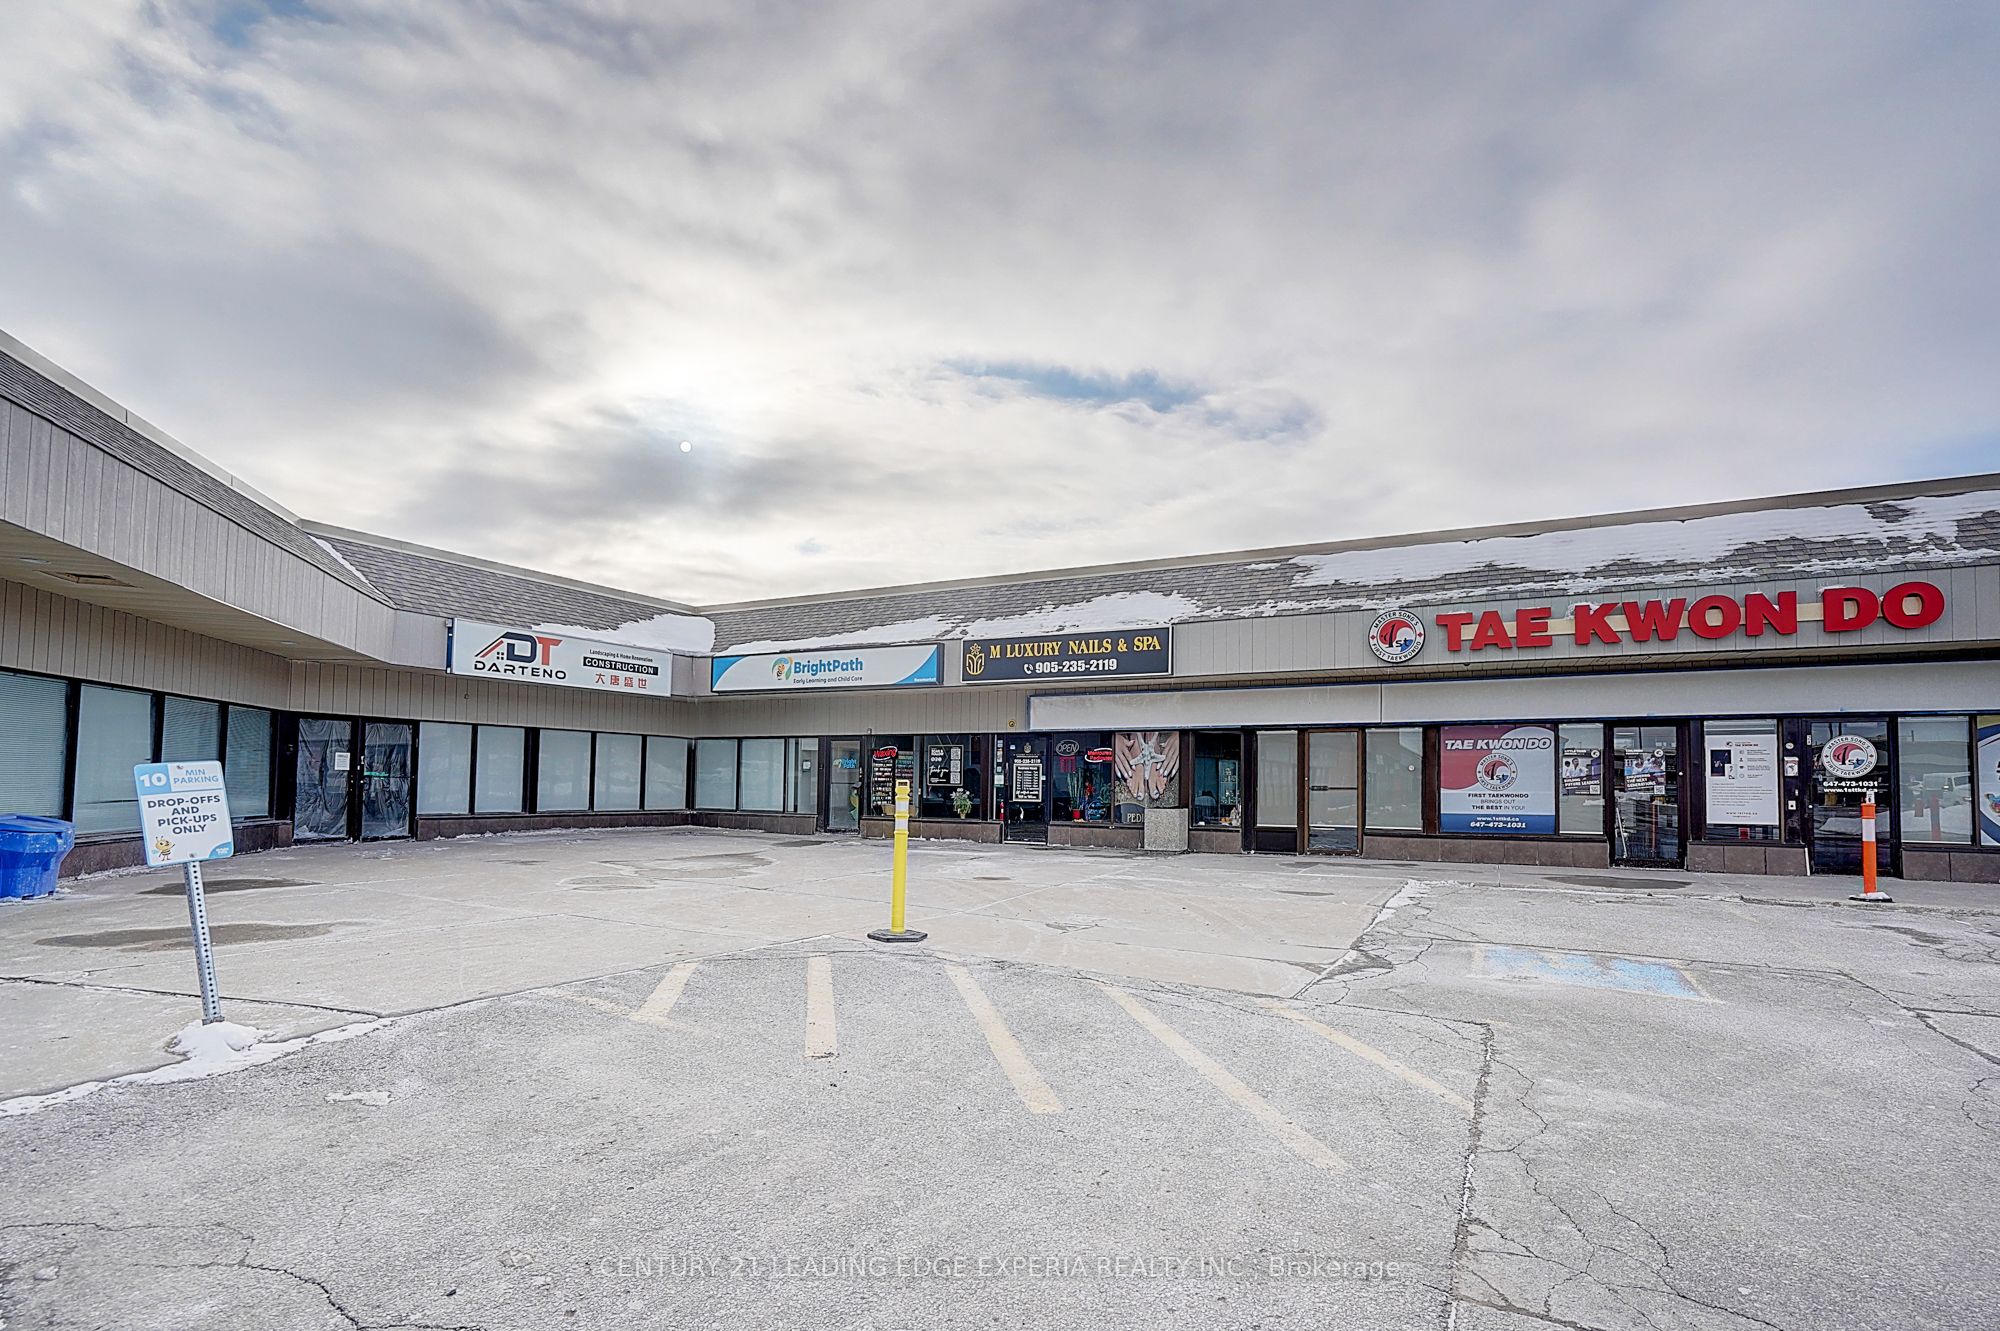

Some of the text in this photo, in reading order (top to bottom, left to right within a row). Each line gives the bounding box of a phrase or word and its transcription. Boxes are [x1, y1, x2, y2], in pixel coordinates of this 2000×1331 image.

[1374, 611, 1419, 628] MASTER SONG'S
[1436, 582, 1945, 651] TAE KWON DO
[589, 649, 616, 659] Landscaping
[990, 635, 1161, 659] M LUXURY NAILS & SPA
[1372, 641, 1422, 661] FIRST TAEKWONDO
[474, 660, 567, 680] DARTENO
[585, 658, 654, 674] CONSTRUCTION
[794, 657, 863, 676] BrightPath
[1035, 658, 1117, 674] 905-235-2119
[595, 673, 647, 689] 大唐盛世
[1059, 743, 1077, 753] OPEN
[1445, 737, 1552, 750] TAE KWON DO
[1827, 737, 1849, 749] MASTER
[1480, 755, 1497, 766] MASTER
[185, 769, 206, 777] MIN
[1826, 760, 1873, 776] FIRST TAEKWONDO
[140, 772, 167, 788] 10
[173, 775, 219, 784] PARKING
[147, 795, 220, 809] DROP-OFFS
[171, 806, 199, 816] AND
[1127, 813, 1145, 823] PEDI
[157, 814, 217, 827] PICK-UPS
[172, 824, 207, 835] ONLY
